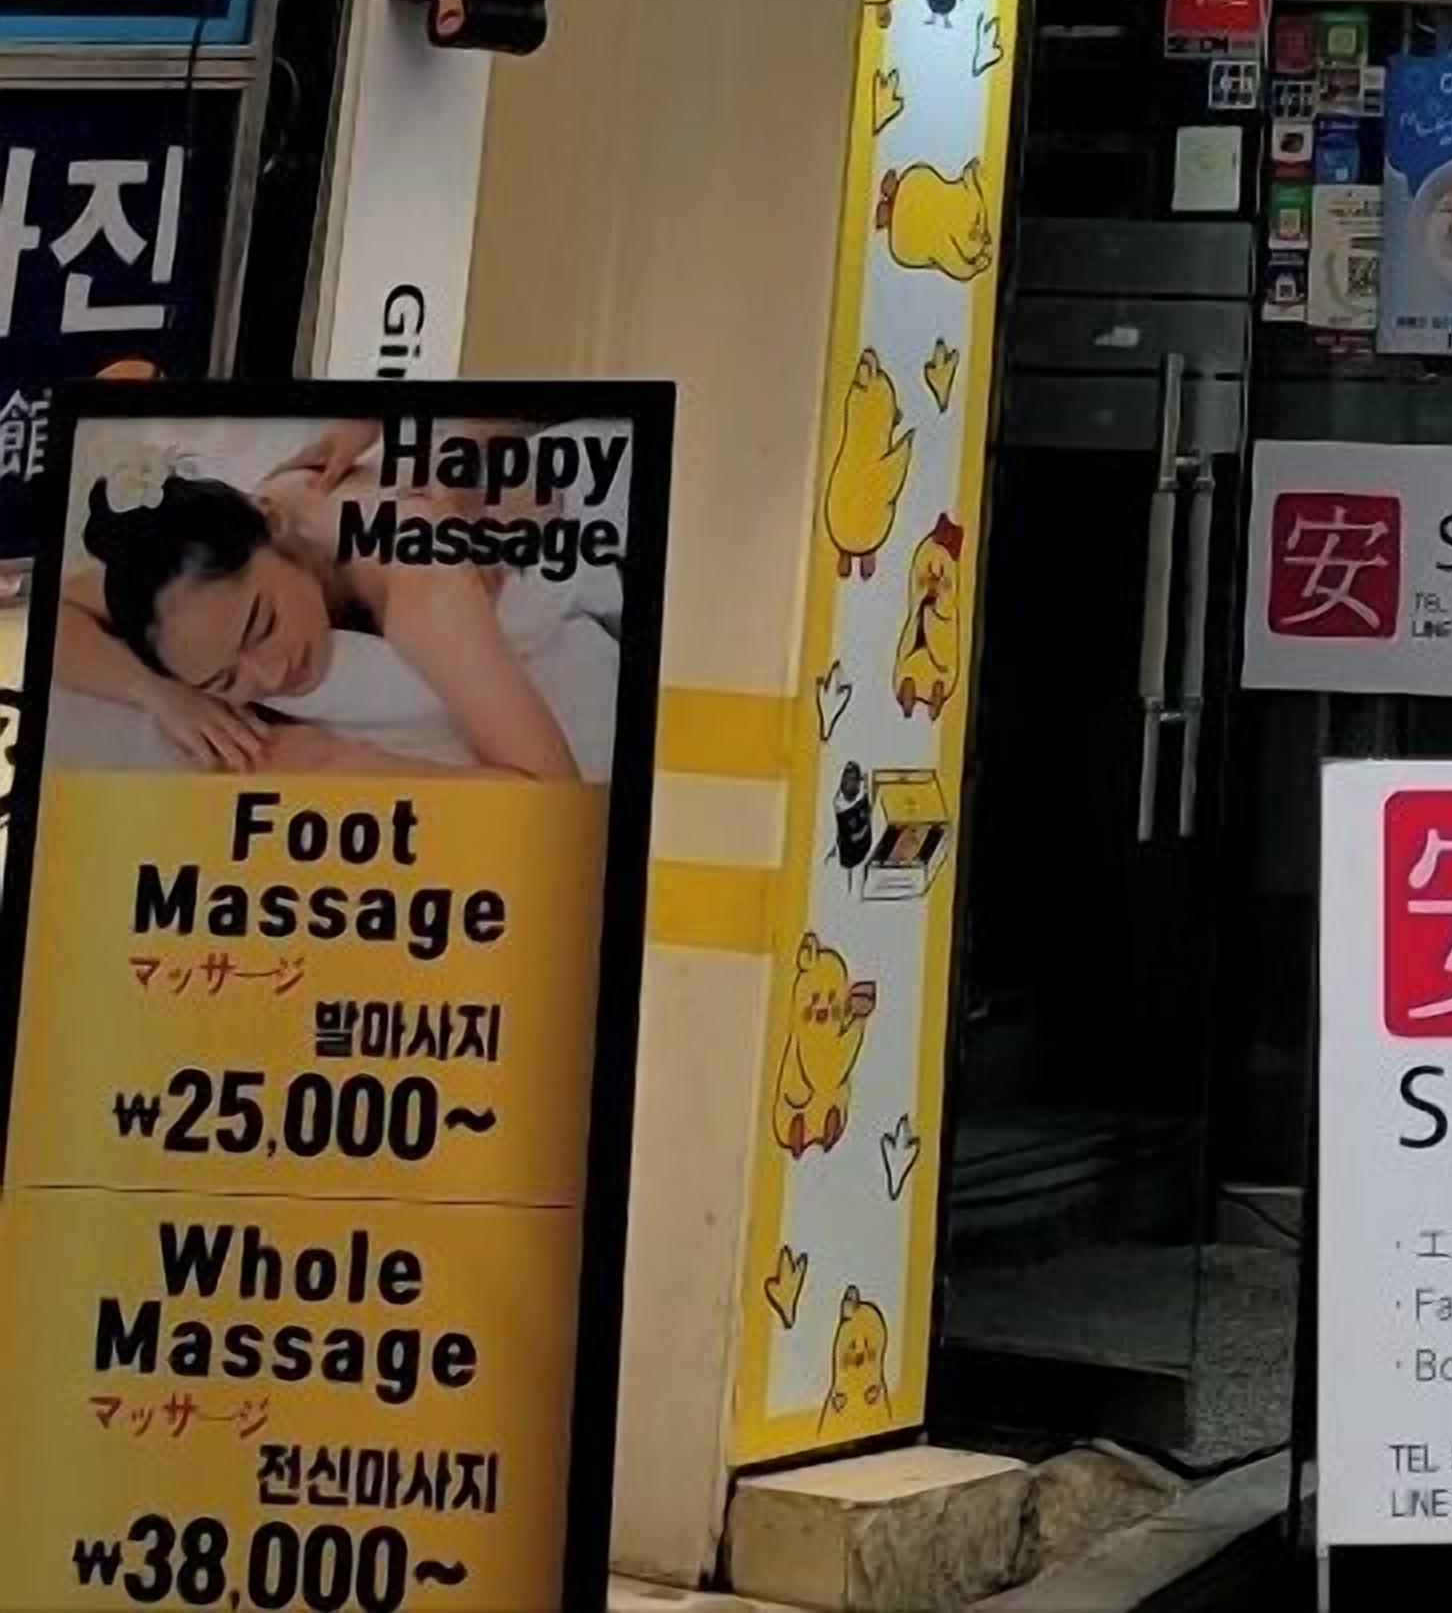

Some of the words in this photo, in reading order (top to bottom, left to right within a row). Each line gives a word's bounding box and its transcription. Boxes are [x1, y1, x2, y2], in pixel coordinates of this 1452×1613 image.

[378, 417, 627, 507] Happy
[336, 499, 621, 576] Massage
[1282, 507, 1392, 631] 安
[231, 791, 418, 866] Foot
[132, 865, 507, 961] Massage
[127, 954, 306, 995] マッサージ
[313, 1001, 501, 1065] 발마사지
[160, 1221, 423, 1307] Whole
[93, 1295, 477, 1405] Massage
[90, 1394, 271, 1437] マッサージ
[256, 1447, 499, 1514] 전신마사지
[1388, 1443, 1440, 1474] TEL
[1391, 1488, 1449, 1518] LINE
